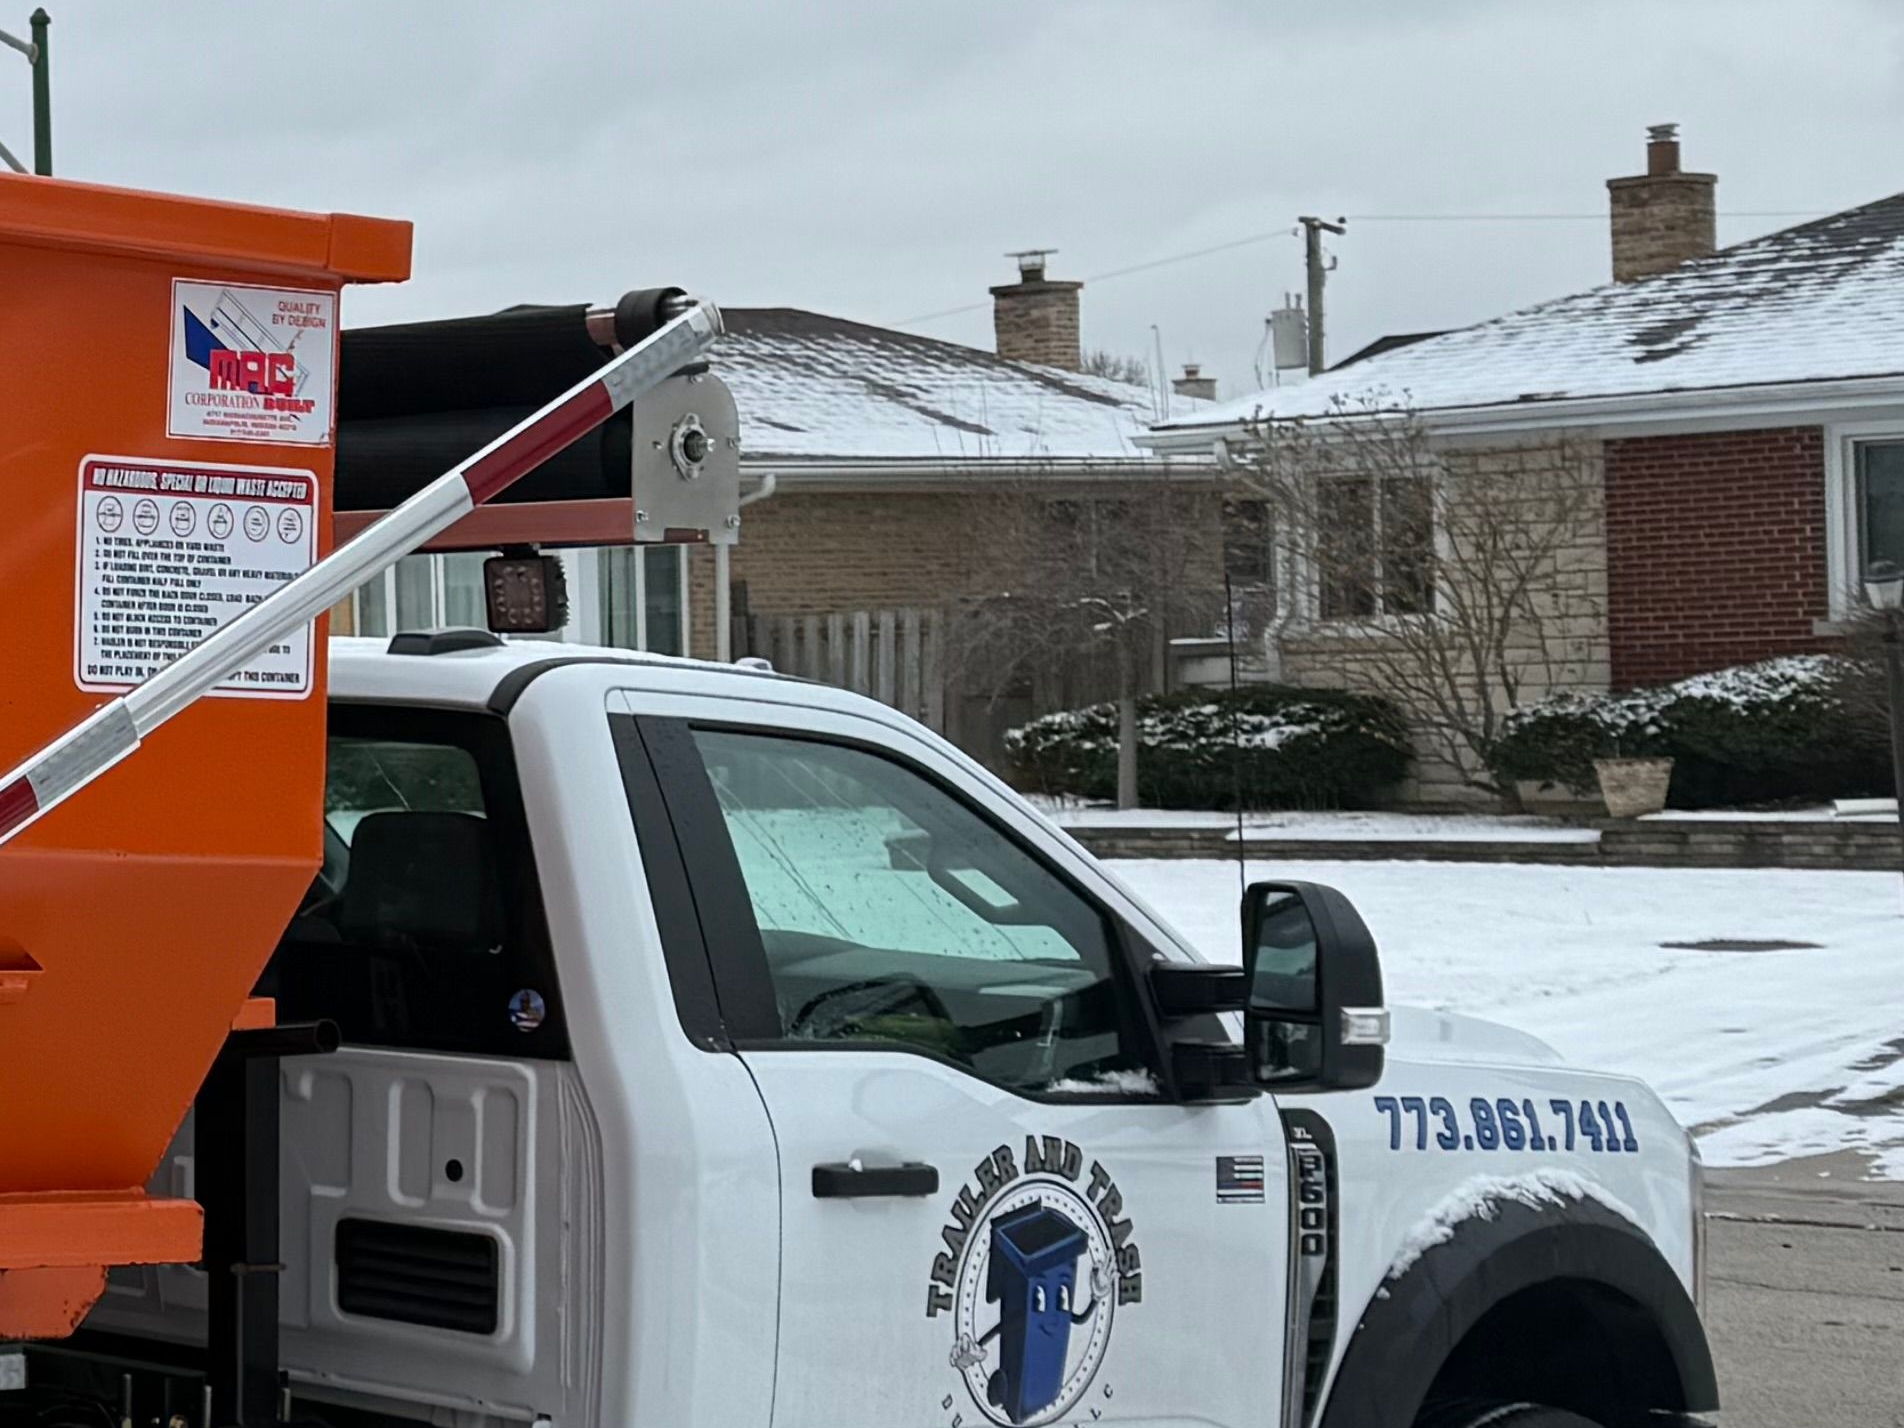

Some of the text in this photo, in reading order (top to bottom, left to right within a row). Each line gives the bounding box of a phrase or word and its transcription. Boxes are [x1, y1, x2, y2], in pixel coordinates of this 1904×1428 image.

[278, 301, 321, 315] QUALITY
[272, 313, 326, 329] BY DESIGN
[185, 391, 260, 410] CORPORATION
[1373, 1096, 1639, 1153] 773.861.7411
[927, 1134, 1143, 1318] TRAILER AND TRASH
